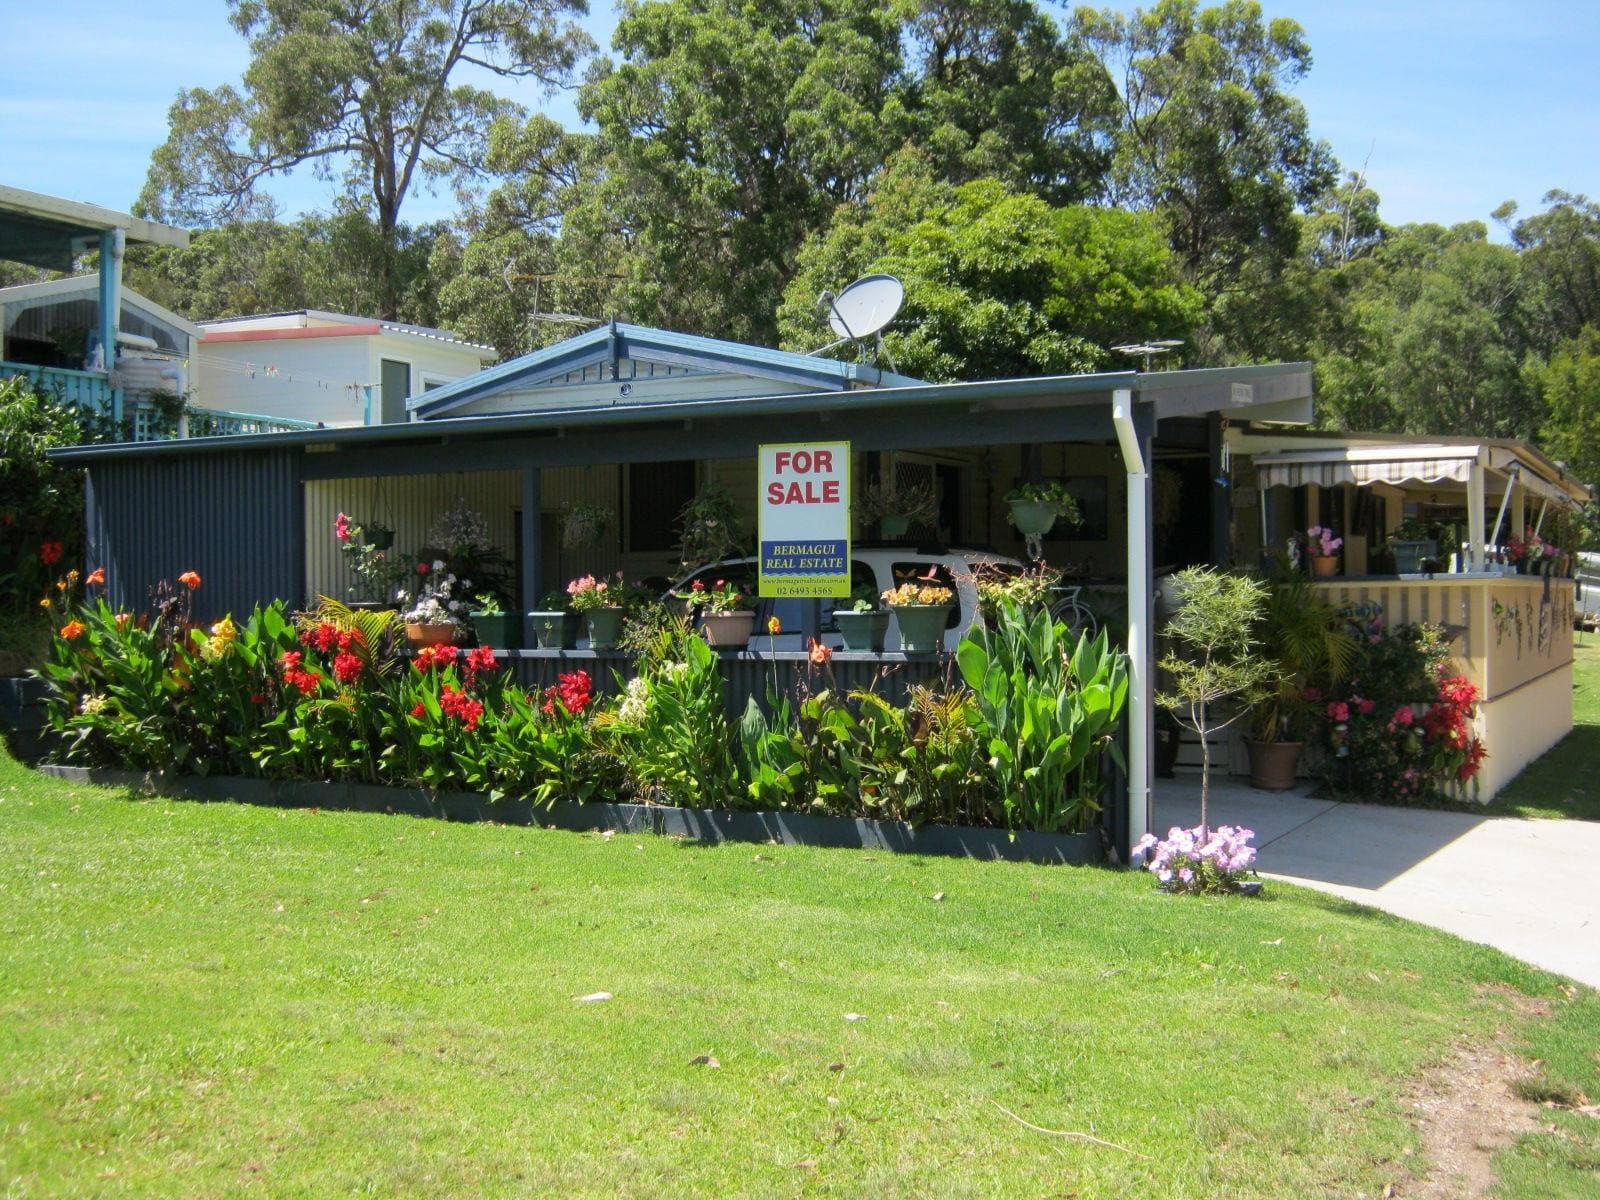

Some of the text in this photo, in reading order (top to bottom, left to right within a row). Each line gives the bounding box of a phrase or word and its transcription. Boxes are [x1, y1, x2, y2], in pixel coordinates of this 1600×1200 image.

[775, 450, 833, 475] FOR
[767, 480, 840, 505] SALE
[773, 544, 836, 556] BERMAGUI
[766, 557, 843, 569] REAL ESTATE
[776, 587, 787, 595] 02
[789, 587, 810, 595] 6493
